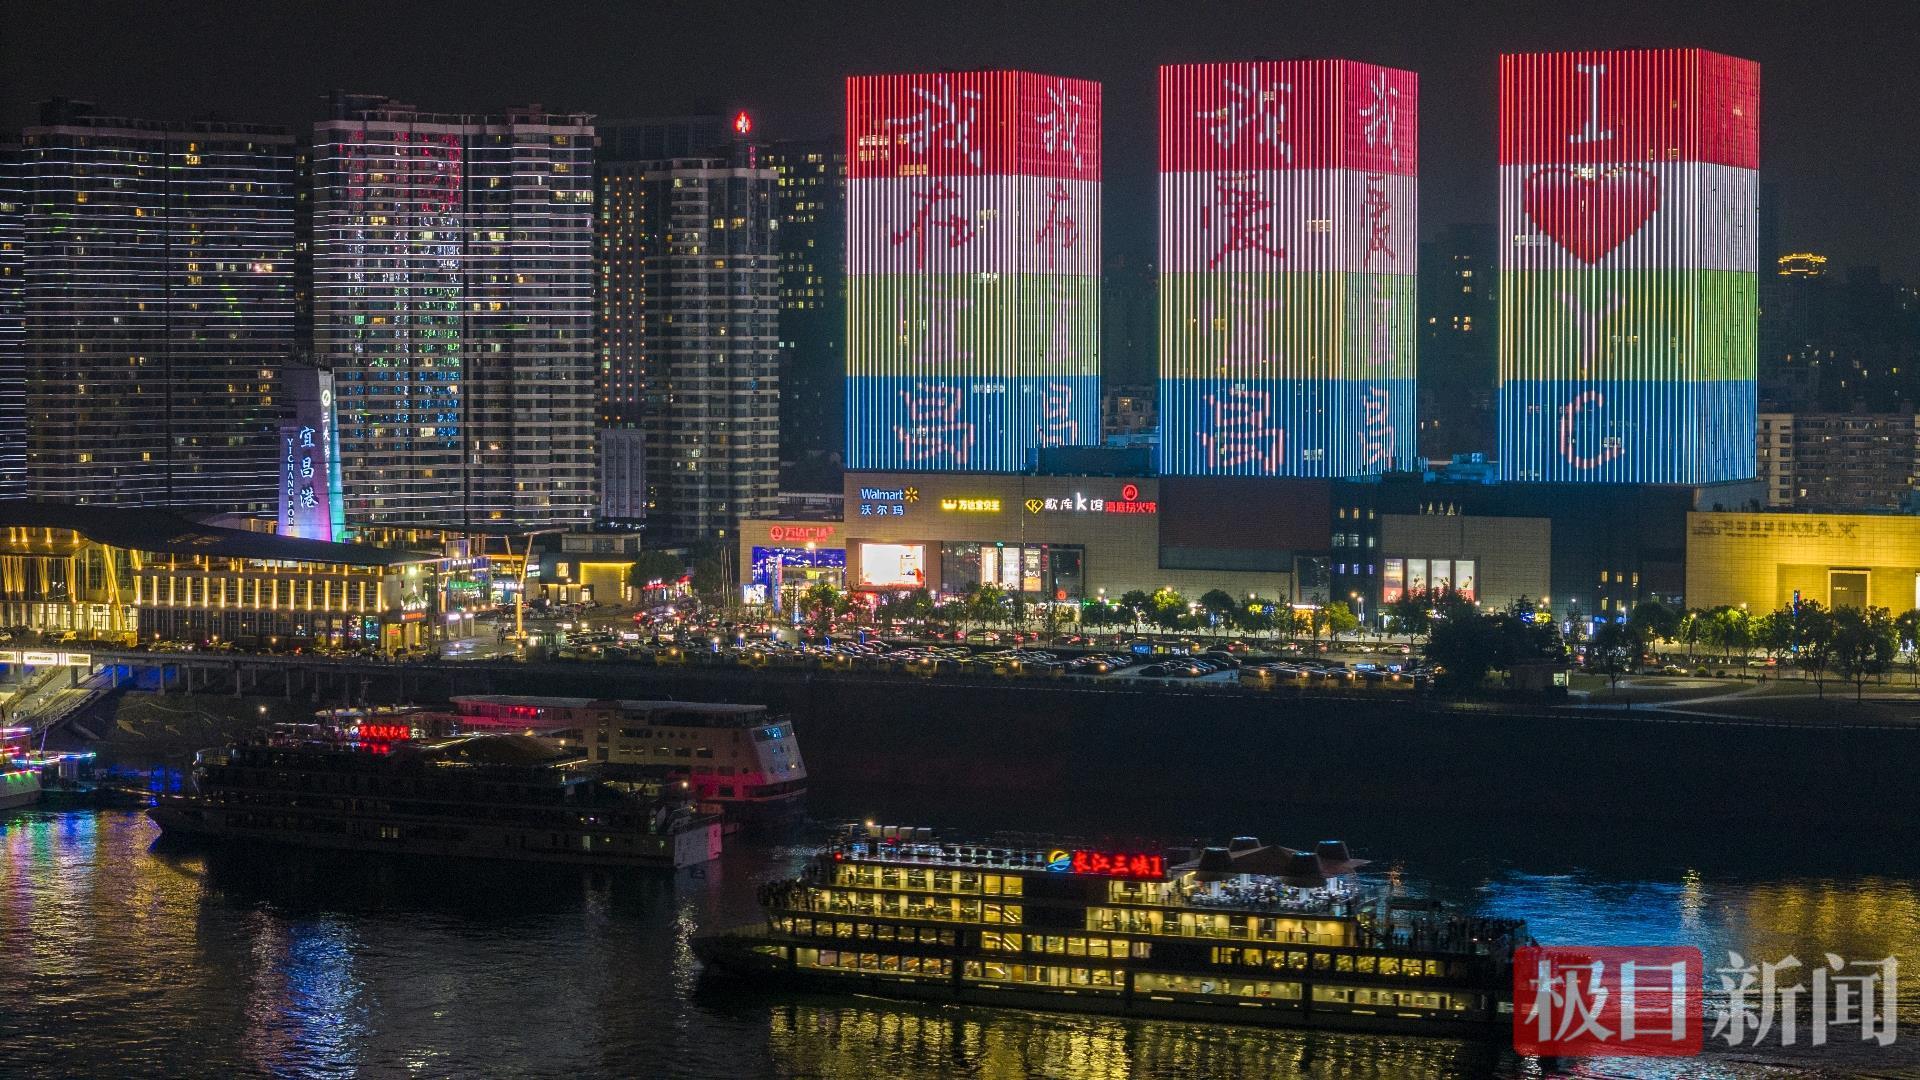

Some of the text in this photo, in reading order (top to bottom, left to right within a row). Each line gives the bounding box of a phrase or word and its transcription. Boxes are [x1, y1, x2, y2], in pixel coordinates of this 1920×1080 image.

[299, 426, 319, 509] 宜昌港
[287, 438, 295, 534] YICHANG PORT
[861, 488, 904, 500] Walmart
[861, 504, 904, 516] 沃尔玛
[1105, 501, 1157, 513] 海底捞火锅
[785, 527, 827, 538] 万达广场
[1073, 851, 1162, 875] 长江三峡1
